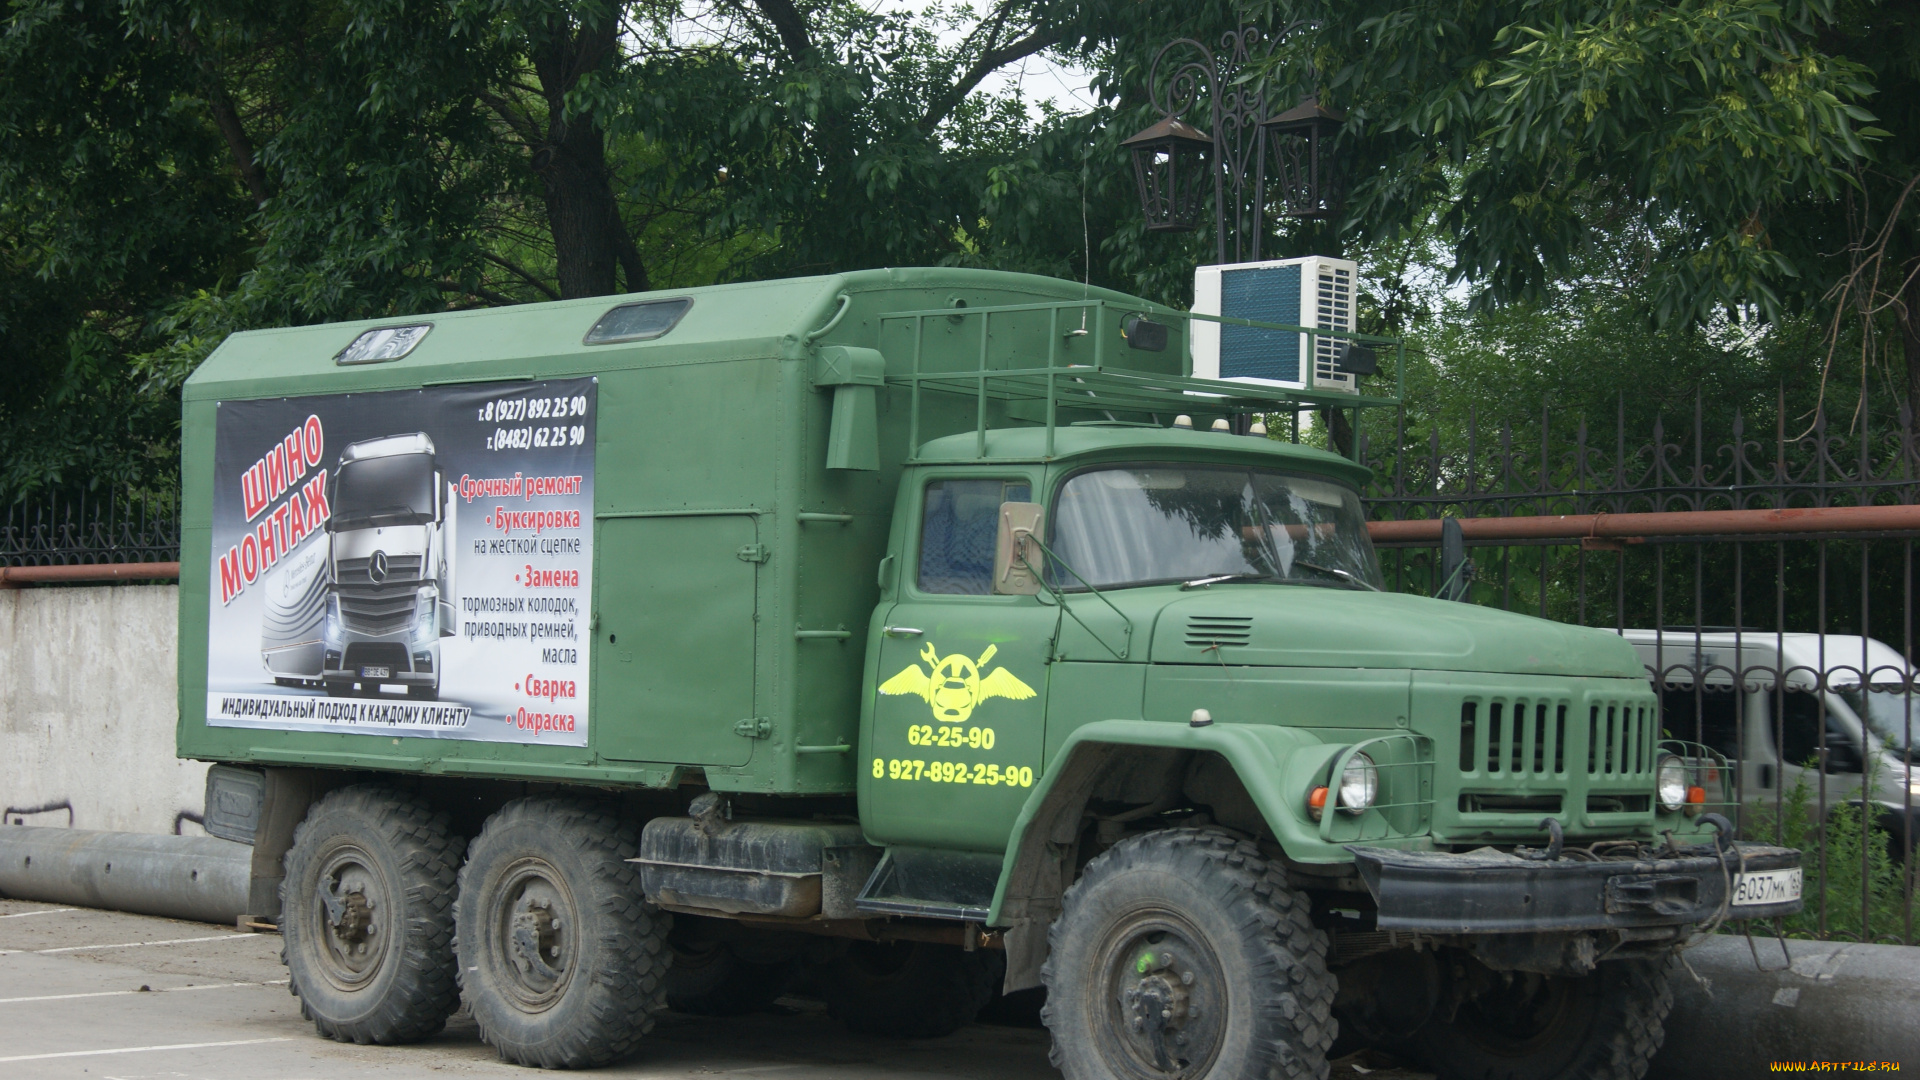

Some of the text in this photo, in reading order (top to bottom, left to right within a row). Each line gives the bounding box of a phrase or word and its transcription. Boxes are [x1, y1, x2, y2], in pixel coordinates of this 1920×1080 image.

[495, 397, 527, 423] (927)
[527, 398, 551, 419] 892
[551, 397, 569, 417] 25
[569, 395, 587, 416] 90
[494, 426, 532, 451] (8482)
[533, 427, 550, 447] 62
[550, 426, 567, 447] 25
[569, 425, 585, 446] 90
[241, 414, 324, 522] ШИНО
[460, 472, 582, 503] Срочный ремонт
[494, 506, 580, 535] Буксировка
[219, 469, 331, 606] МОНТАЖ
[474, 534, 580, 557] на жесткой сцепке
[524, 564, 579, 587] Замена
[462, 597, 579, 616] тормозных колодок,
[464, 618, 578, 642] приводных ремней,
[542, 648, 577, 664] масла
[525, 673, 576, 702] Сварка
[221, 697, 471, 727] ИНДИВИДУАЛЬНЫЙ ПОДХОД К КАЖДОМУ КЛИЕНТУ
[516, 706, 575, 736] Окраска
[908, 724, 995, 750] 62-25-90
[872, 758, 1033, 788] 8 927-892-25-90
